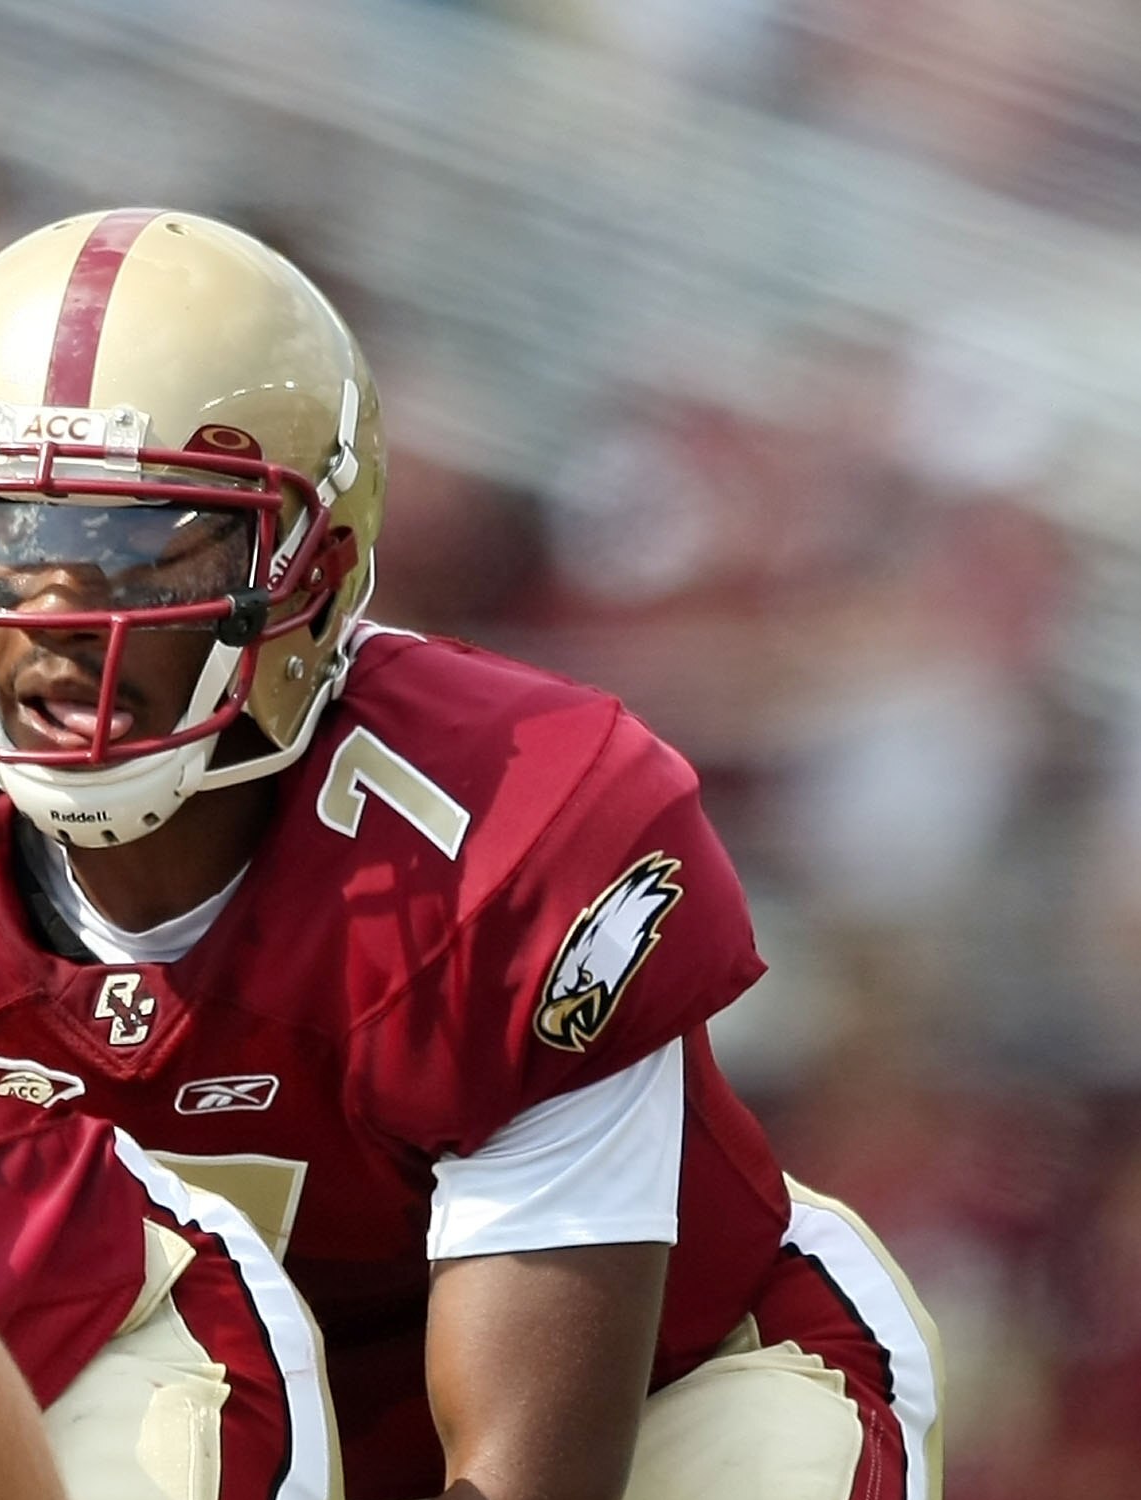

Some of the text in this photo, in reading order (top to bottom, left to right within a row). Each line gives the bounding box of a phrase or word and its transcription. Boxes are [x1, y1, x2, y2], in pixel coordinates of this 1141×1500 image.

[22, 414, 91, 440] ACC
[316, 725, 471, 861] 7
[50, 809, 107, 823] Riddell
[8, 1085, 40, 1099] ACC
